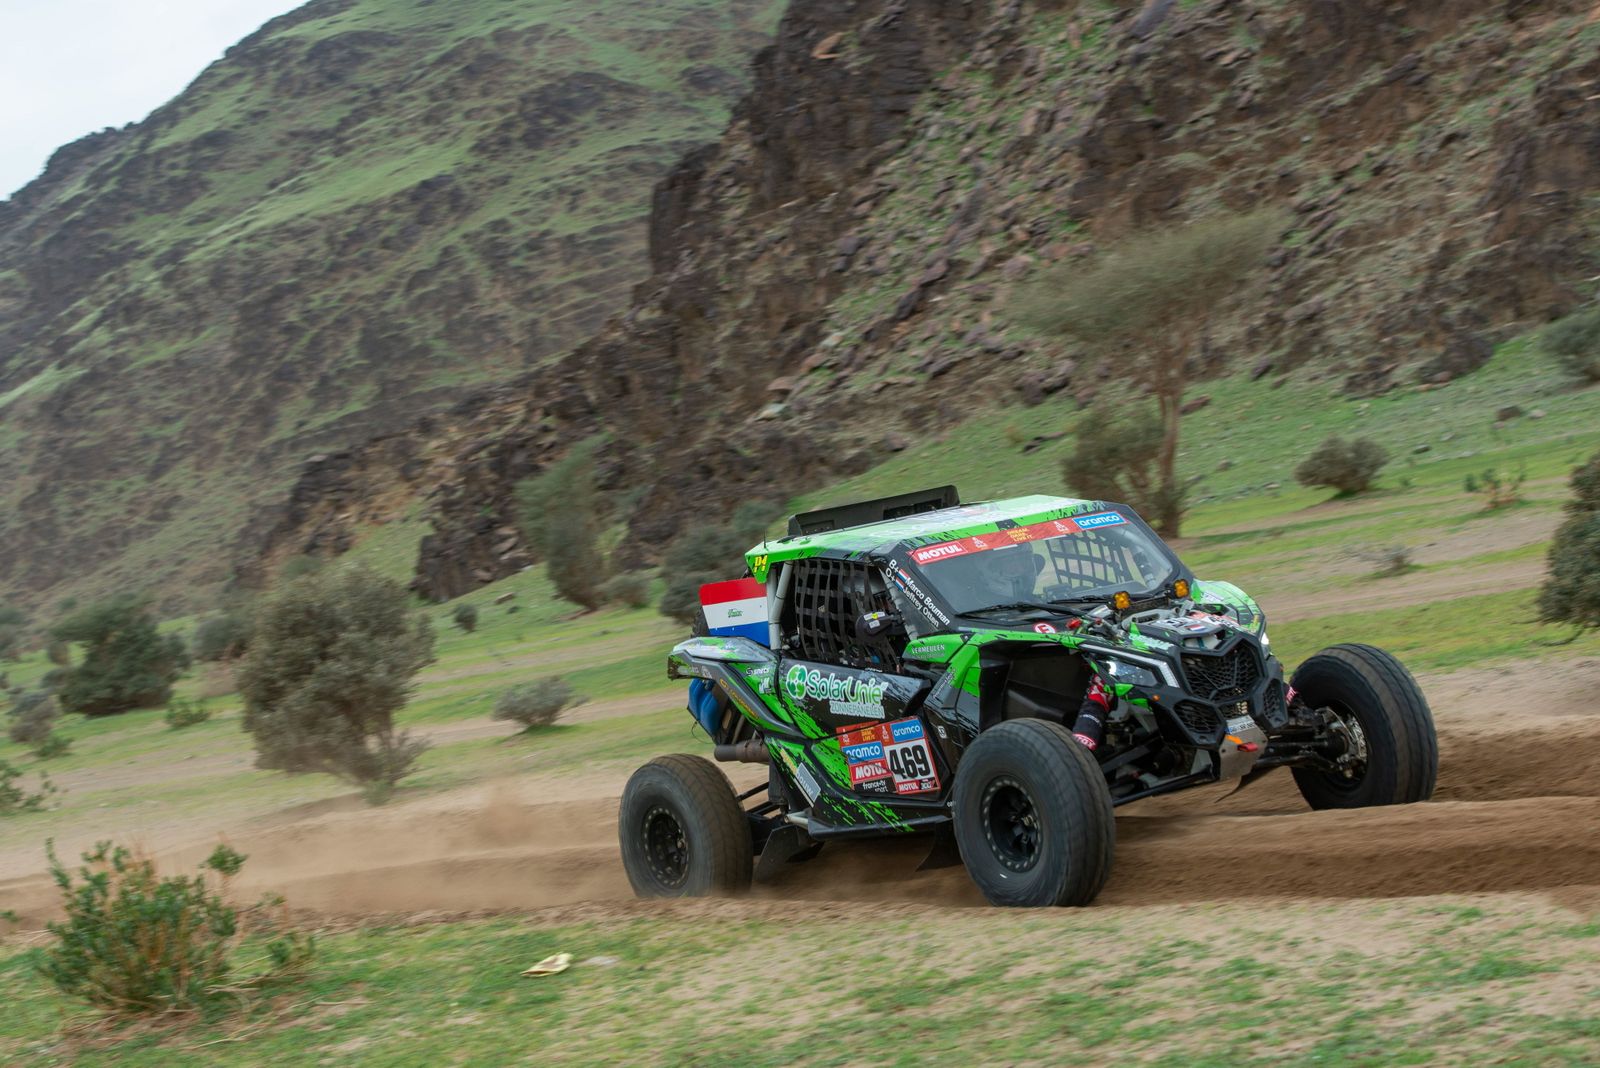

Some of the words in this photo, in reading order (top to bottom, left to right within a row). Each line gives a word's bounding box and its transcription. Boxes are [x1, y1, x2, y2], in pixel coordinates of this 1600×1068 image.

[1078, 514, 1121, 527] aramco
[918, 544, 962, 561] MOTUL
[889, 559, 899, 573] B+
[885, 568, 896, 582] O+
[902, 586, 922, 611] Jeffrey
[922, 607, 939, 627] Otten
[905, 577, 925, 600] Marco
[924, 596, 951, 626] Bouman
[911, 643, 945, 654] VERMEULEN
[806, 669, 883, 704] SolarUnie
[830, 702, 884, 717] ZONNEPANELEN
[893, 724, 921, 737] aramco
[846, 745, 881, 760] aramco
[889, 744, 931, 780] 469
[898, 781, 918, 792] MOTUL
